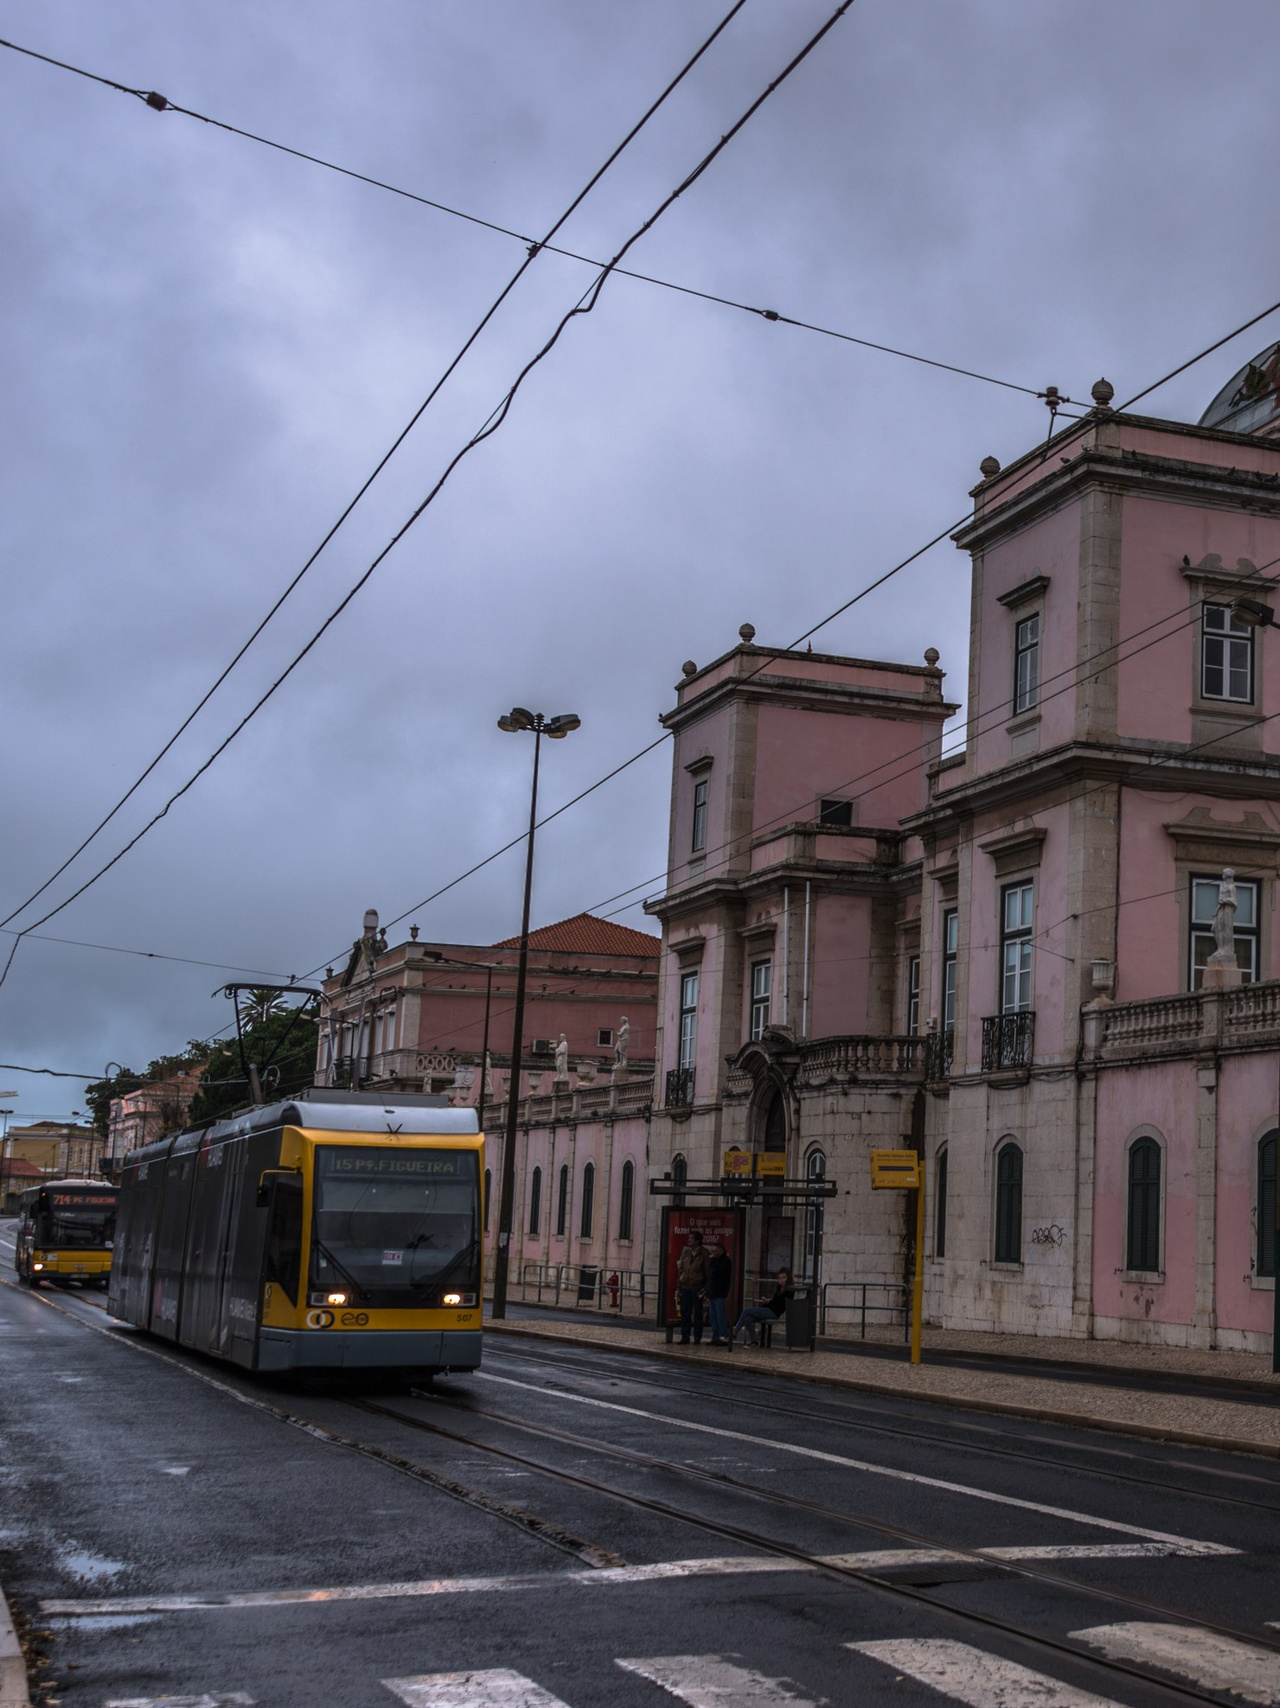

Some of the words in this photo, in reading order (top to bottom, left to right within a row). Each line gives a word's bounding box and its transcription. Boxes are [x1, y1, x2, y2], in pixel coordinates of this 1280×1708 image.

[336, 1158, 353, 1171] 15
[53, 1194, 71, 1205] 714
[689, 1218, 695, 1226] O
[696, 1219, 708, 1228] que
[709, 1218, 722, 1226] vais
[674, 1226, 690, 1234] fazer
[457, 1314, 473, 1322] 507
